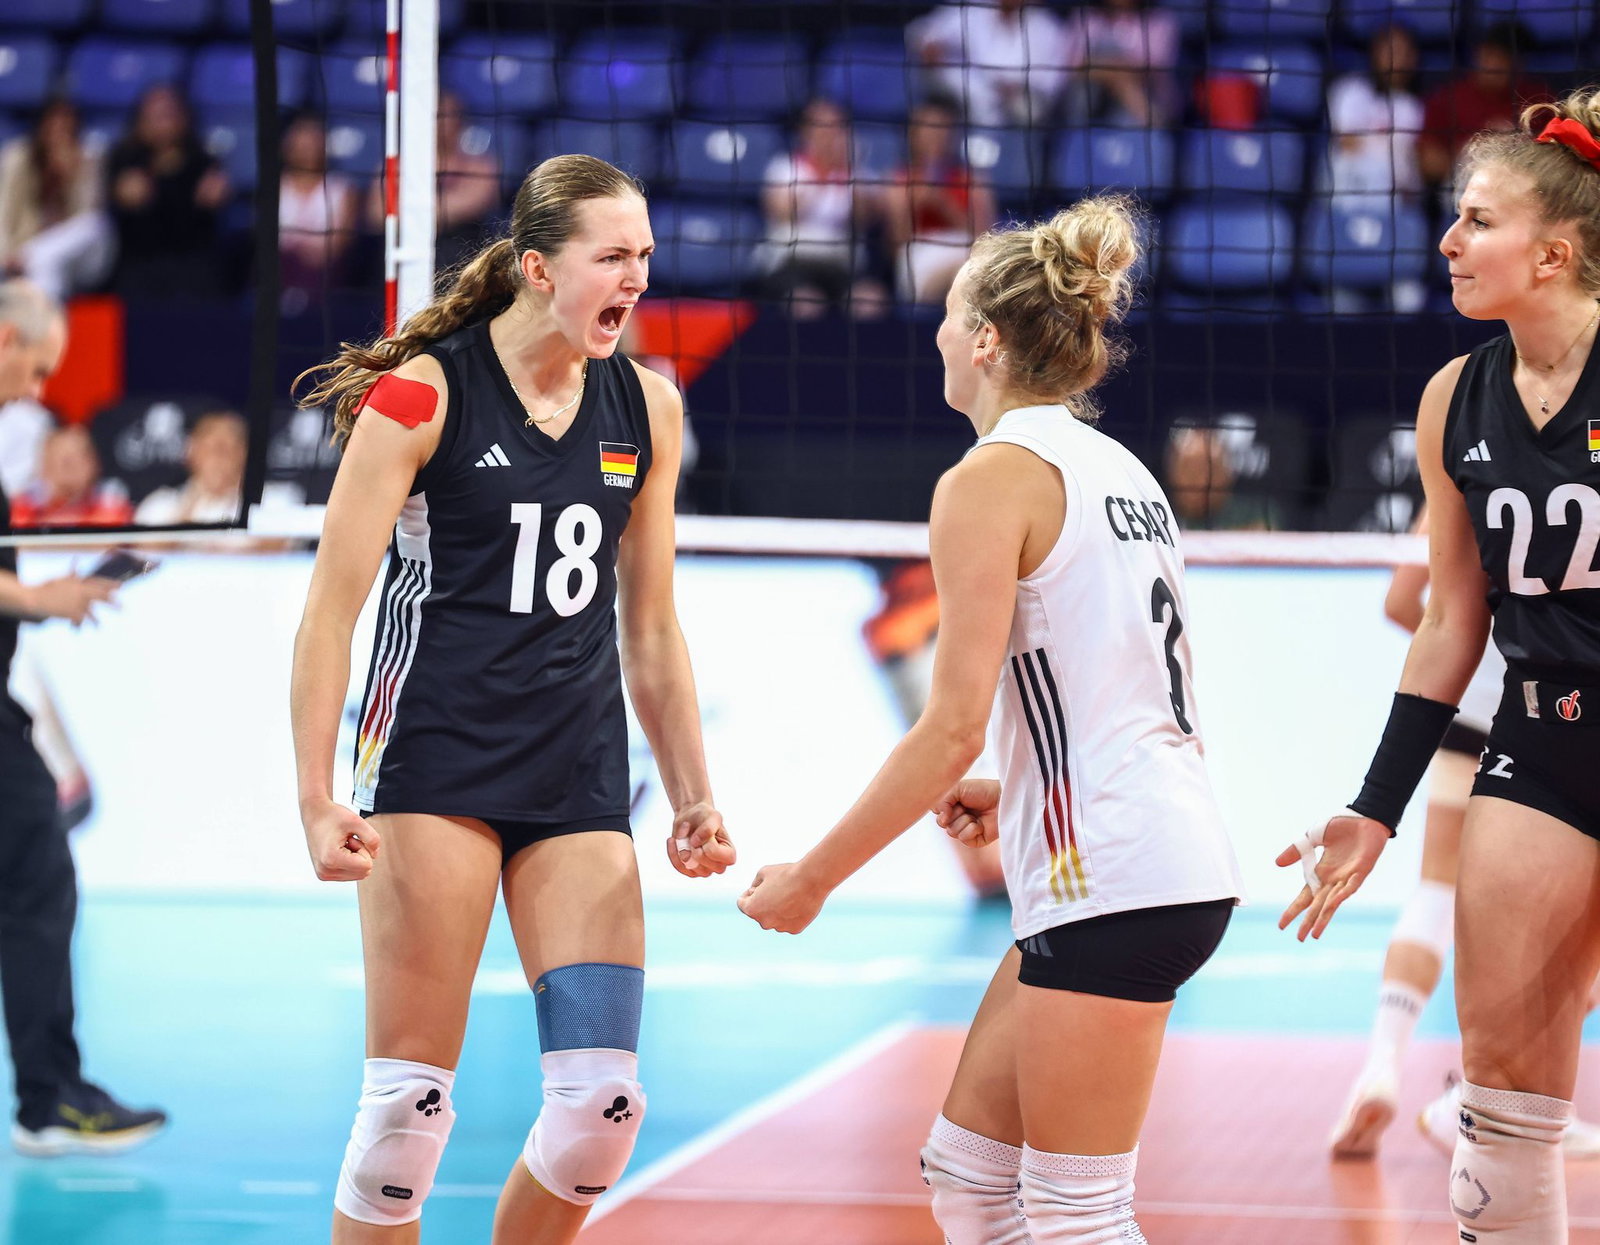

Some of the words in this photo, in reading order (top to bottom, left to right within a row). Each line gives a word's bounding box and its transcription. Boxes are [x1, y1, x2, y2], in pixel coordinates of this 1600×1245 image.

[603, 473, 635, 489] GERMANY
[509, 503, 603, 617] 18
[1486, 483, 1600, 596] 22
